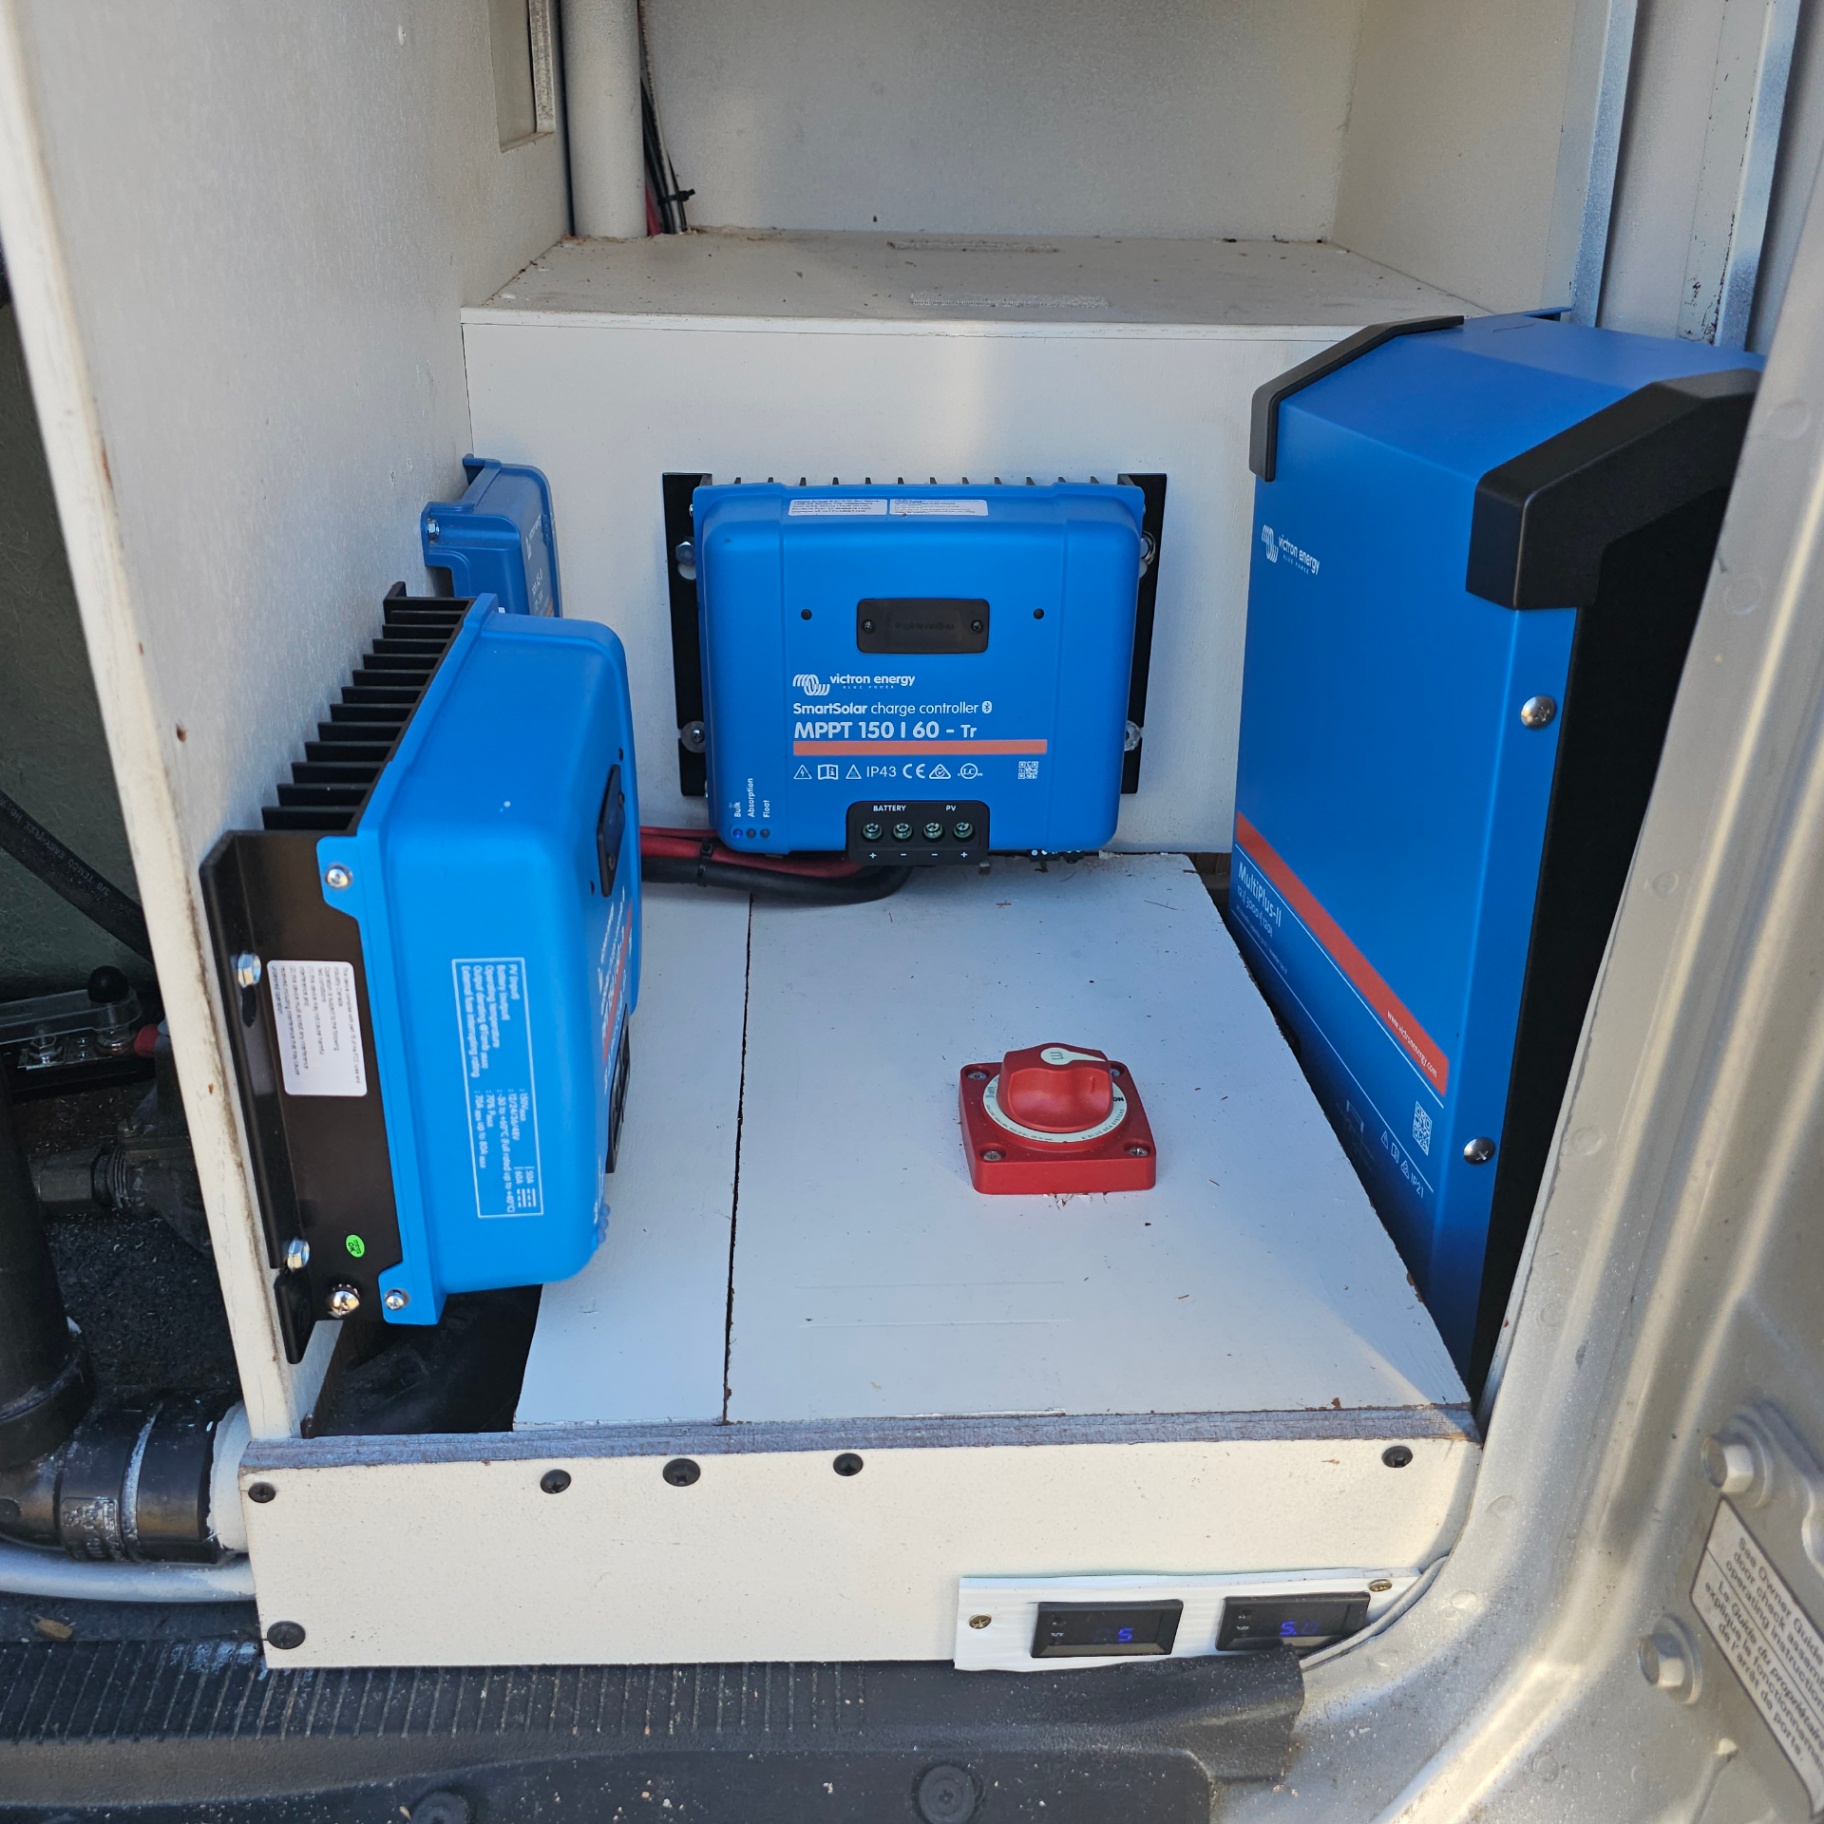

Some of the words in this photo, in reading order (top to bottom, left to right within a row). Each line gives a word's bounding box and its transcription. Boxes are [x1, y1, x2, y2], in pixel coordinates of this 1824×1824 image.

[1278, 534, 1297, 558] victron
[1299, 549, 1320, 575] energy
[830, 673, 870, 684] victron
[874, 675, 915, 686] energy
[793, 702, 868, 715] SmartSolar
[871, 703, 915, 716] charge
[919, 702, 979, 714] controller
[794, 722, 853, 739] MPPT
[859, 721, 894, 739] 150
[913, 721, 940, 739] 60
[961, 725, 977, 738] Tr
[866, 766, 897, 778] IP43
[747, 778, 755, 817] Absorption
[1238, 861, 1282, 928] MultiPlus-II
[497, 1106, 506, 1114] to
[501, 1152, 511, 1171] rated
[502, 1171, 511, 1180] up
[1410, 1175, 1425, 1199] IP21
[1725, 1560, 1769, 1629] operating
[1733, 1552, 1755, 1584] door
[1756, 1586, 1785, 1631] check
[1738, 1536, 1756, 1568] See
[1757, 1565, 1791, 1617] Owner
[1792, 1617, 1823, 1665] Guide
[1704, 1582, 1741, 1641] explique
[1742, 1638, 1751, 1657] le
[1717, 1580, 1730, 1603] Le
[1731, 1602, 1756, 1644] Guide
[1756, 1645, 1771, 1665] du
[1718, 1622, 1730, 1643] de
[1736, 1652, 1759, 1688] arrêt
[1760, 1689, 1773, 1710] de
